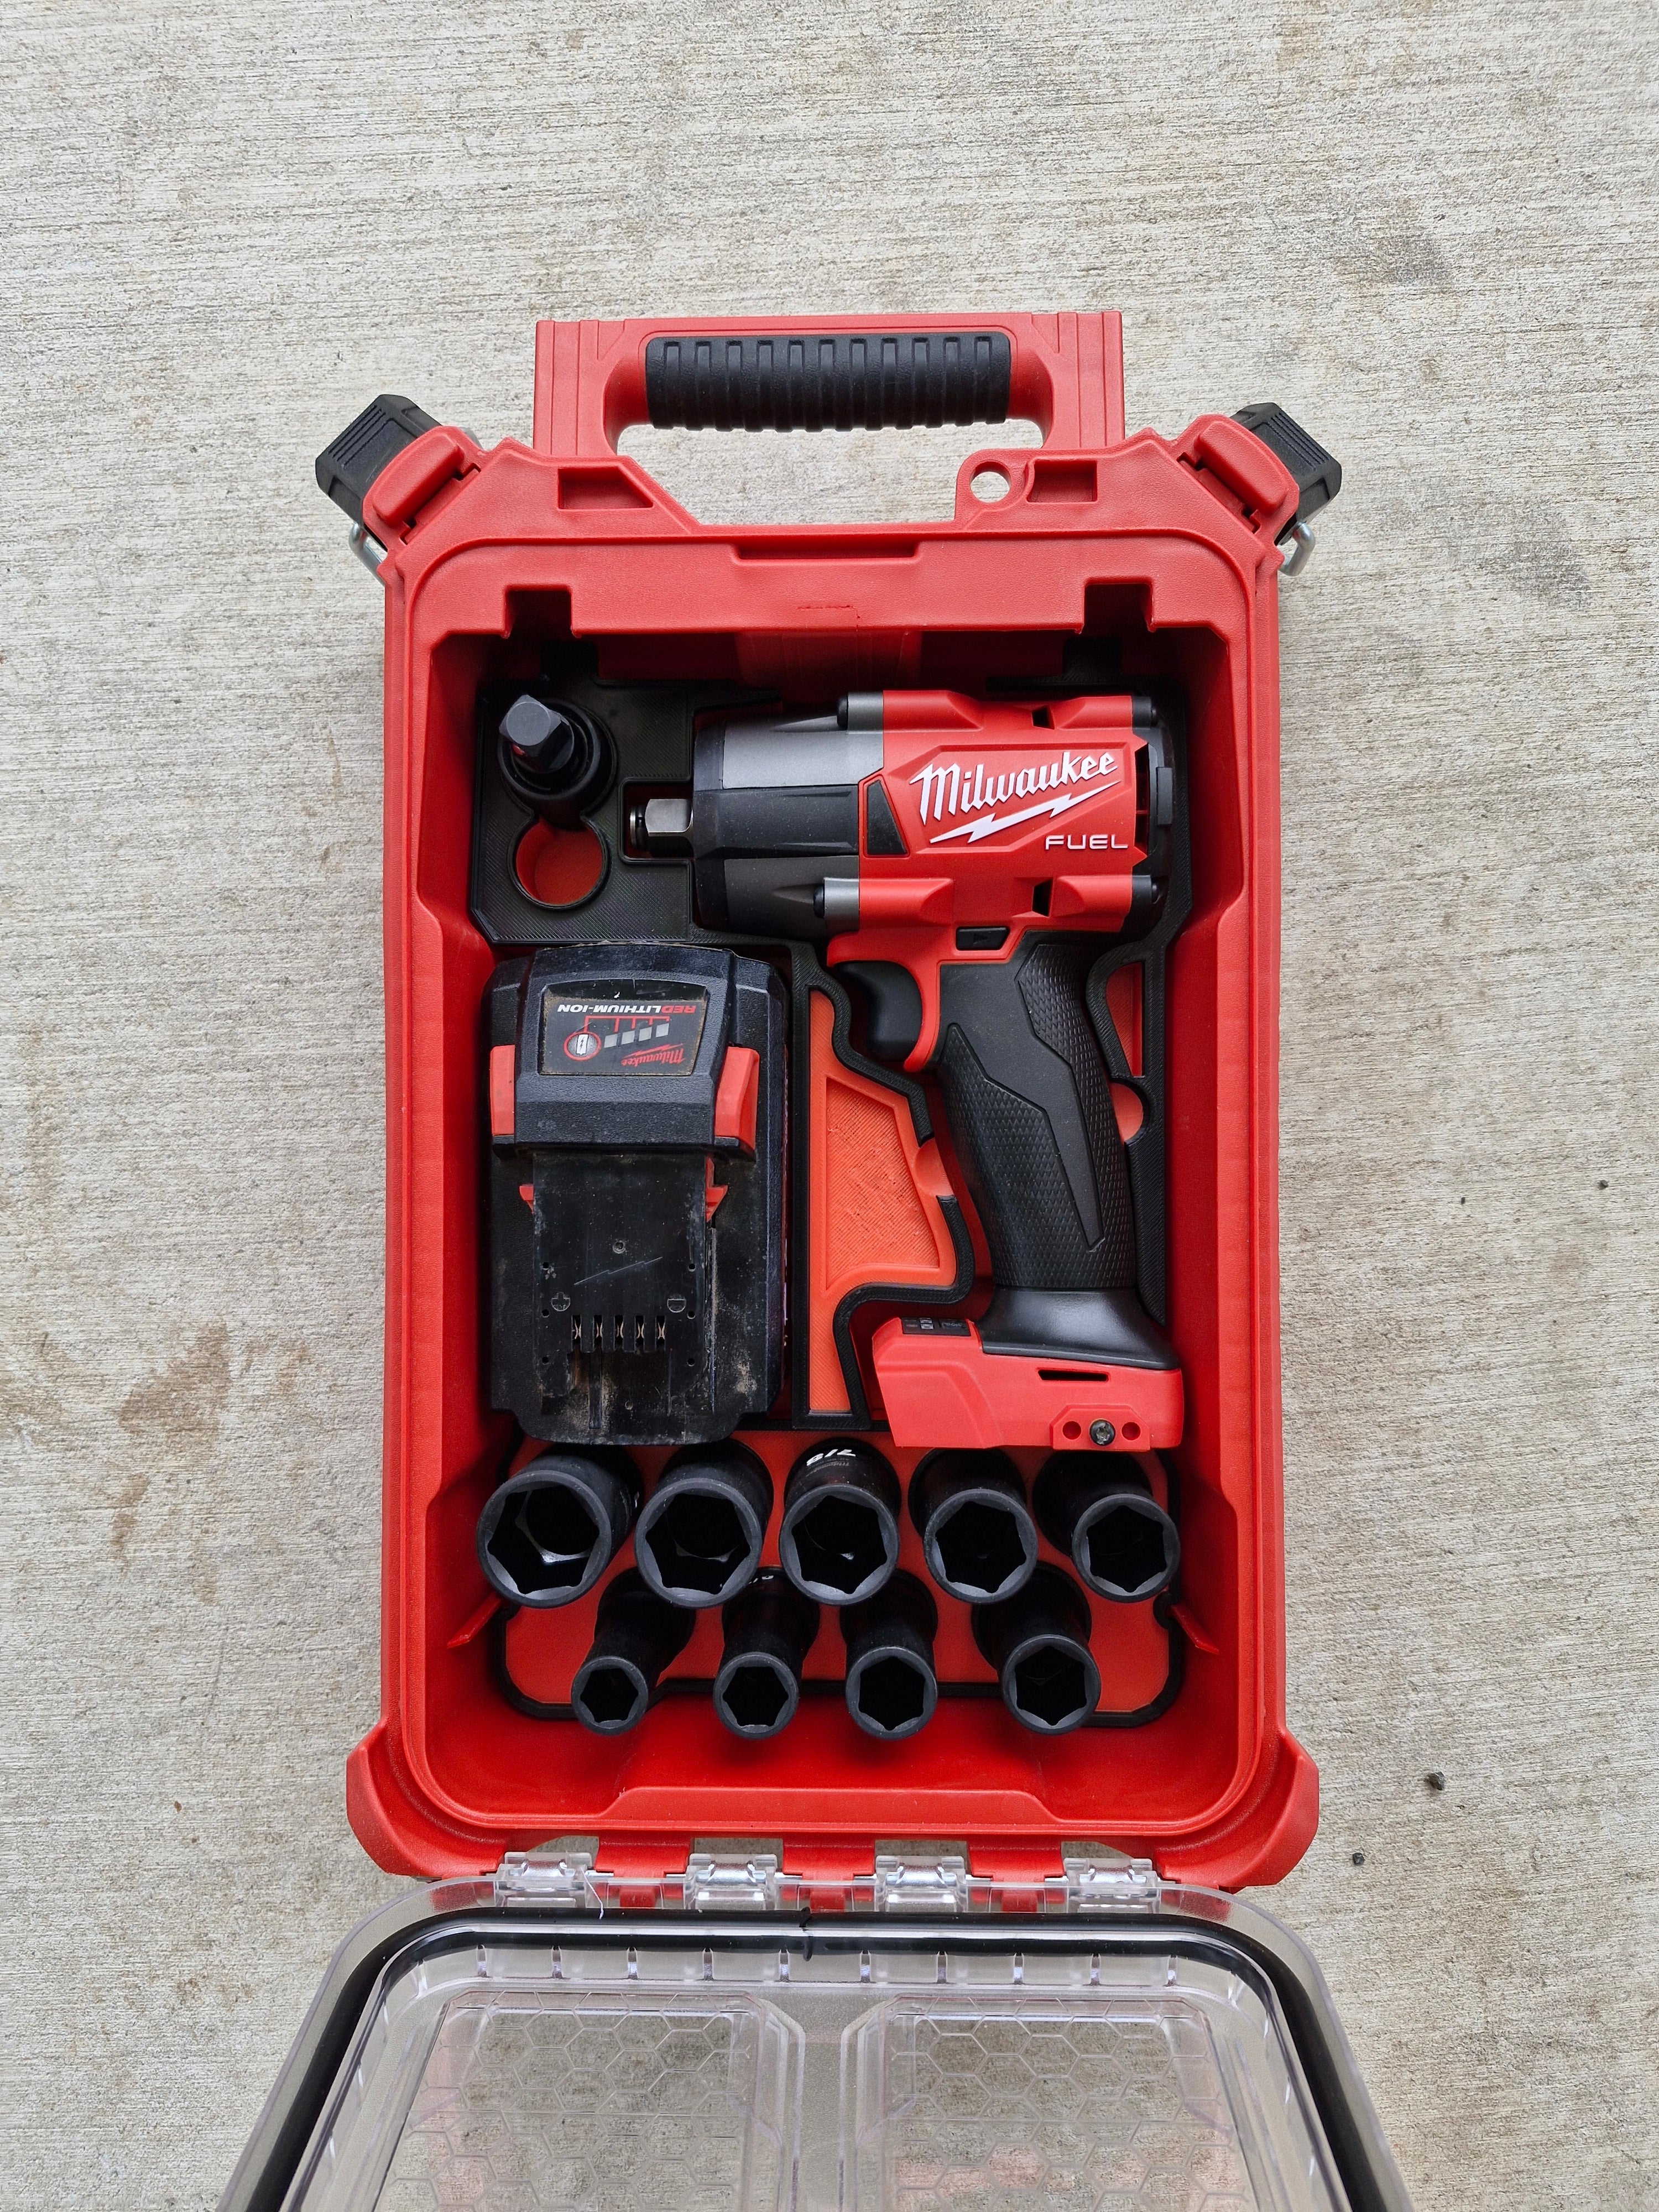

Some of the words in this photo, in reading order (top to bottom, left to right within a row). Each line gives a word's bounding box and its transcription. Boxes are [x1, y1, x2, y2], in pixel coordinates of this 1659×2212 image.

[909, 751, 1118, 826] Milwaukee
[1045, 834, 1128, 850] FUEL
[620, 1048, 686, 1067] Milwaukee
[806, 1449, 856, 1466] 7/8
